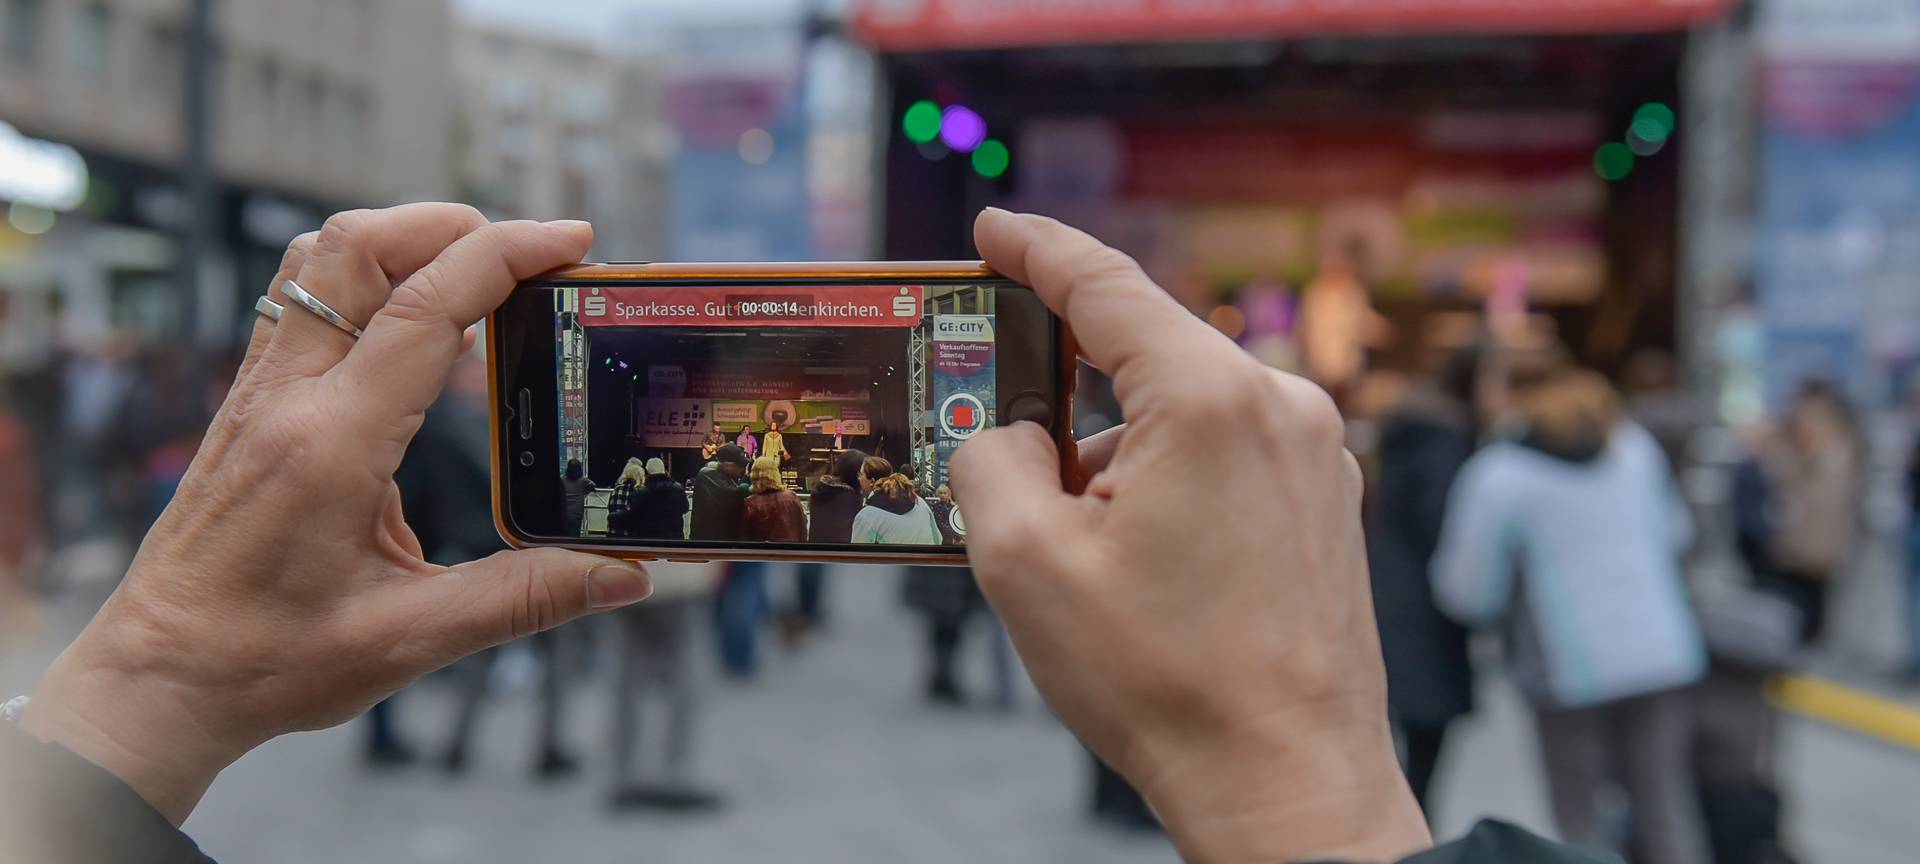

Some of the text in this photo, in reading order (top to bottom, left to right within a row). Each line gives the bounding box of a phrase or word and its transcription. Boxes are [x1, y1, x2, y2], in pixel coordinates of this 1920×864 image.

[615, 301, 699, 319] Sparkasse.
[704, 302, 733, 317] Gut
[762, 301, 884, 317] enkirchen.
[741, 301, 798, 314] 00:00:14
[939, 322, 984, 332] GE:CITY
[939, 343, 989, 351] Verkaufsoffener
[939, 351, 965, 360] Sonntag
[646, 410, 679, 427] ELE
